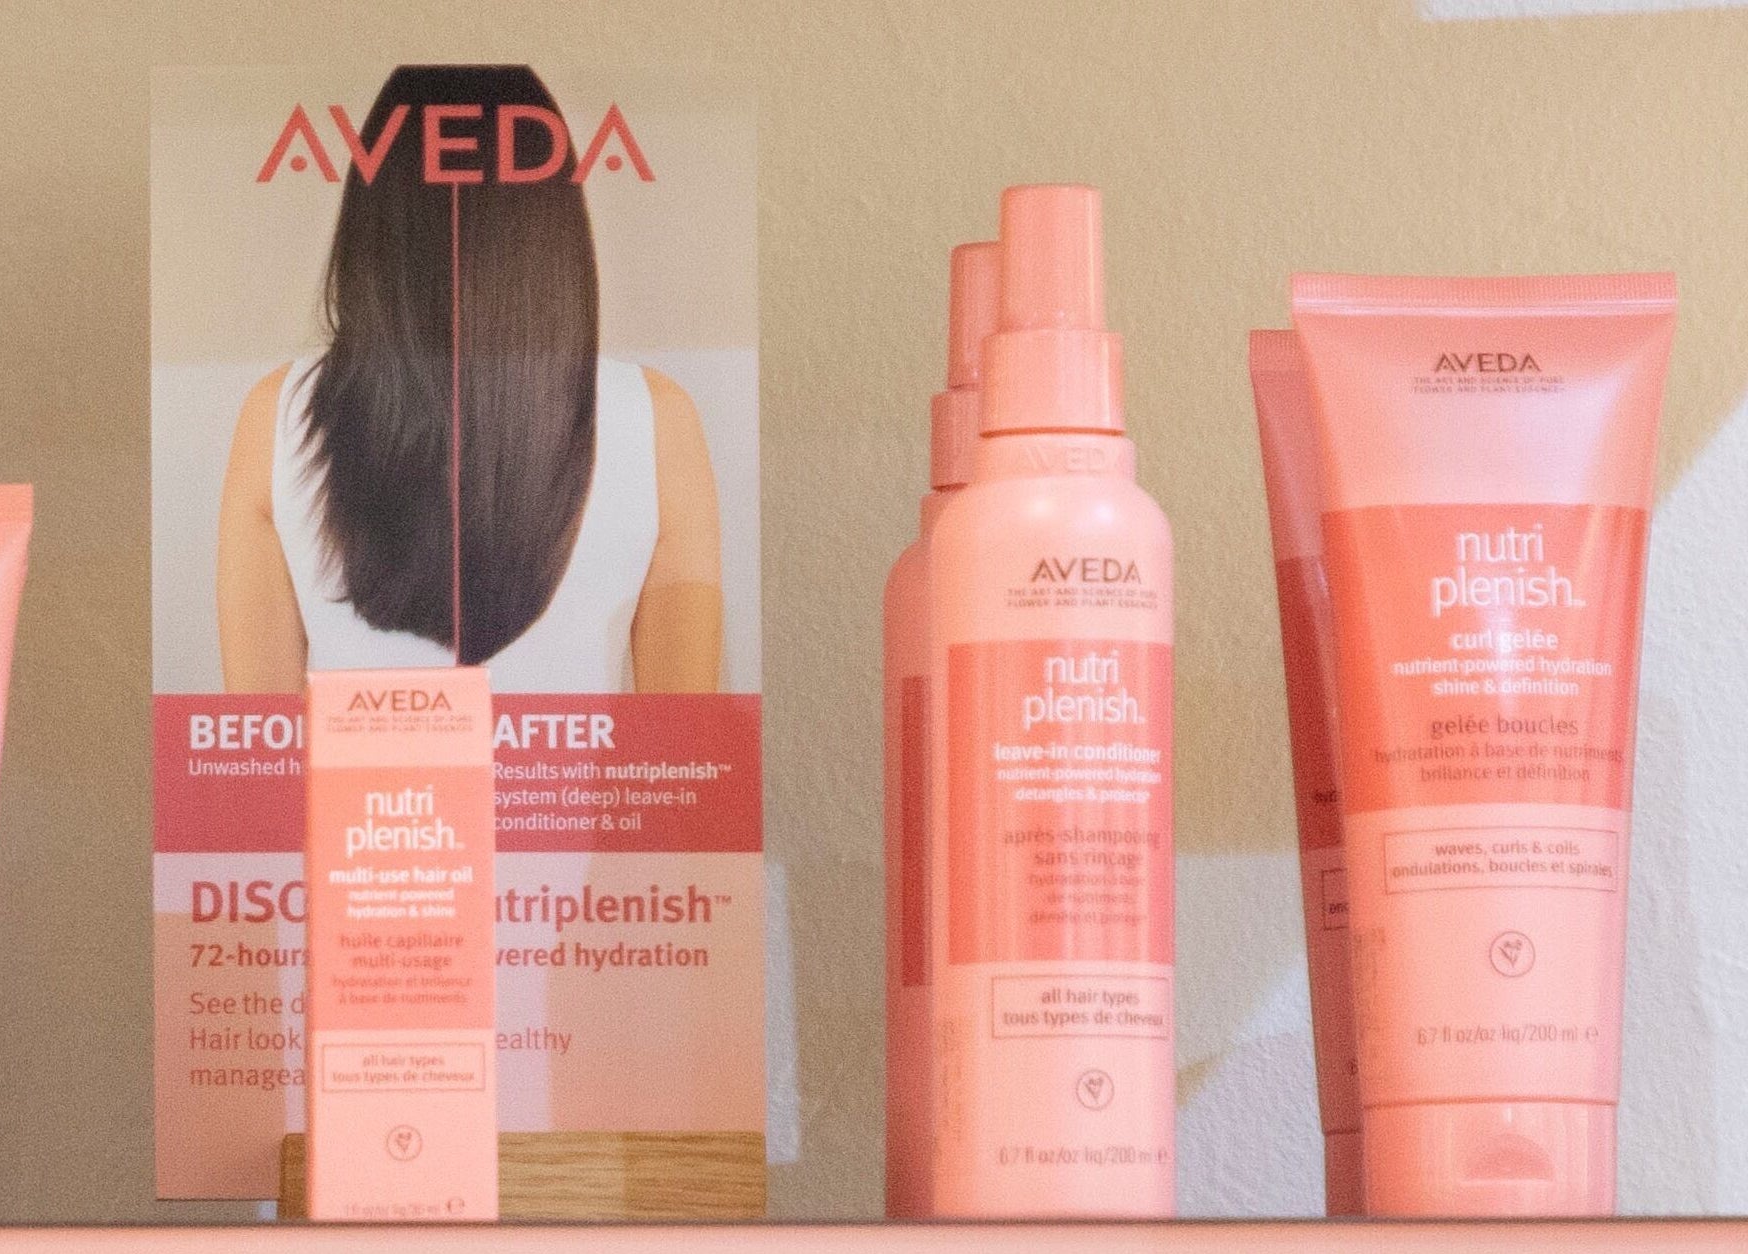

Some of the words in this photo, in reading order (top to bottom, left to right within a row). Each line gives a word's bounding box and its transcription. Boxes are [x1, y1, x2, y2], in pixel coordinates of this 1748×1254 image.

[256, 101, 657, 185] AVEDA
[1434, 353, 1541, 373] AVEDA
[1458, 523, 1544, 562] nutri
[1032, 559, 1141, 584] AVEDA
[1450, 631, 1493, 650] curl
[1497, 629, 1558, 654] gelée
[1044, 650, 1119, 684] nutri
[1393, 658, 1534, 677] nutrient-powered
[1539, 659, 1612, 677] hydration
[1433, 679, 1480, 696] shine
[1484, 680, 1494, 694] &
[1501, 678, 1580, 696] definition
[348, 690, 451, 712] AVEDA
[189, 715, 304, 750] BEFO
[493, 714, 615, 748] AFTER
[1431, 715, 1488, 739] gelée
[1497, 715, 1578, 735] boucles
[994, 743, 1068, 762] leave-in
[1074, 743, 1161, 763] conditioner
[189, 759, 285, 776] Unwashed
[492, 764, 557, 778] Results
[562, 764, 601, 778] with
[366, 785, 433, 817] nutri
[493, 790, 556, 808] system
[562, 788, 620, 808] (deep)
[625, 788, 696, 804] leave-in
[494, 815, 598, 830] conditioner
[602, 815, 614, 830] &
[620, 814, 641, 830] oil
[1435, 841, 1487, 858] waves,
[1492, 841, 1527, 855] curls
[1532, 841, 1542, 855] &
[1548, 841, 1580, 855] coils
[329, 867, 409, 884] multi-use
[414, 867, 448, 883] hair
[452, 867, 473, 883] oil
[1392, 860, 1482, 879] ondulations,
[1489, 859, 1548, 874] boucles
[1551, 860, 1565, 874] et
[1569, 862, 1612, 878] spirales
[193, 881, 305, 924] DISC
[495, 886, 732, 932] triplenish™
[575, 942, 709, 972] hydration
[189, 993, 235, 1015] See
[242, 993, 279, 1014] the
[190, 1028, 250, 1050] Hair
[252, 1028, 301, 1050] look
[496, 1028, 571, 1053] ealthy
[189, 1065, 304, 1090] managea
